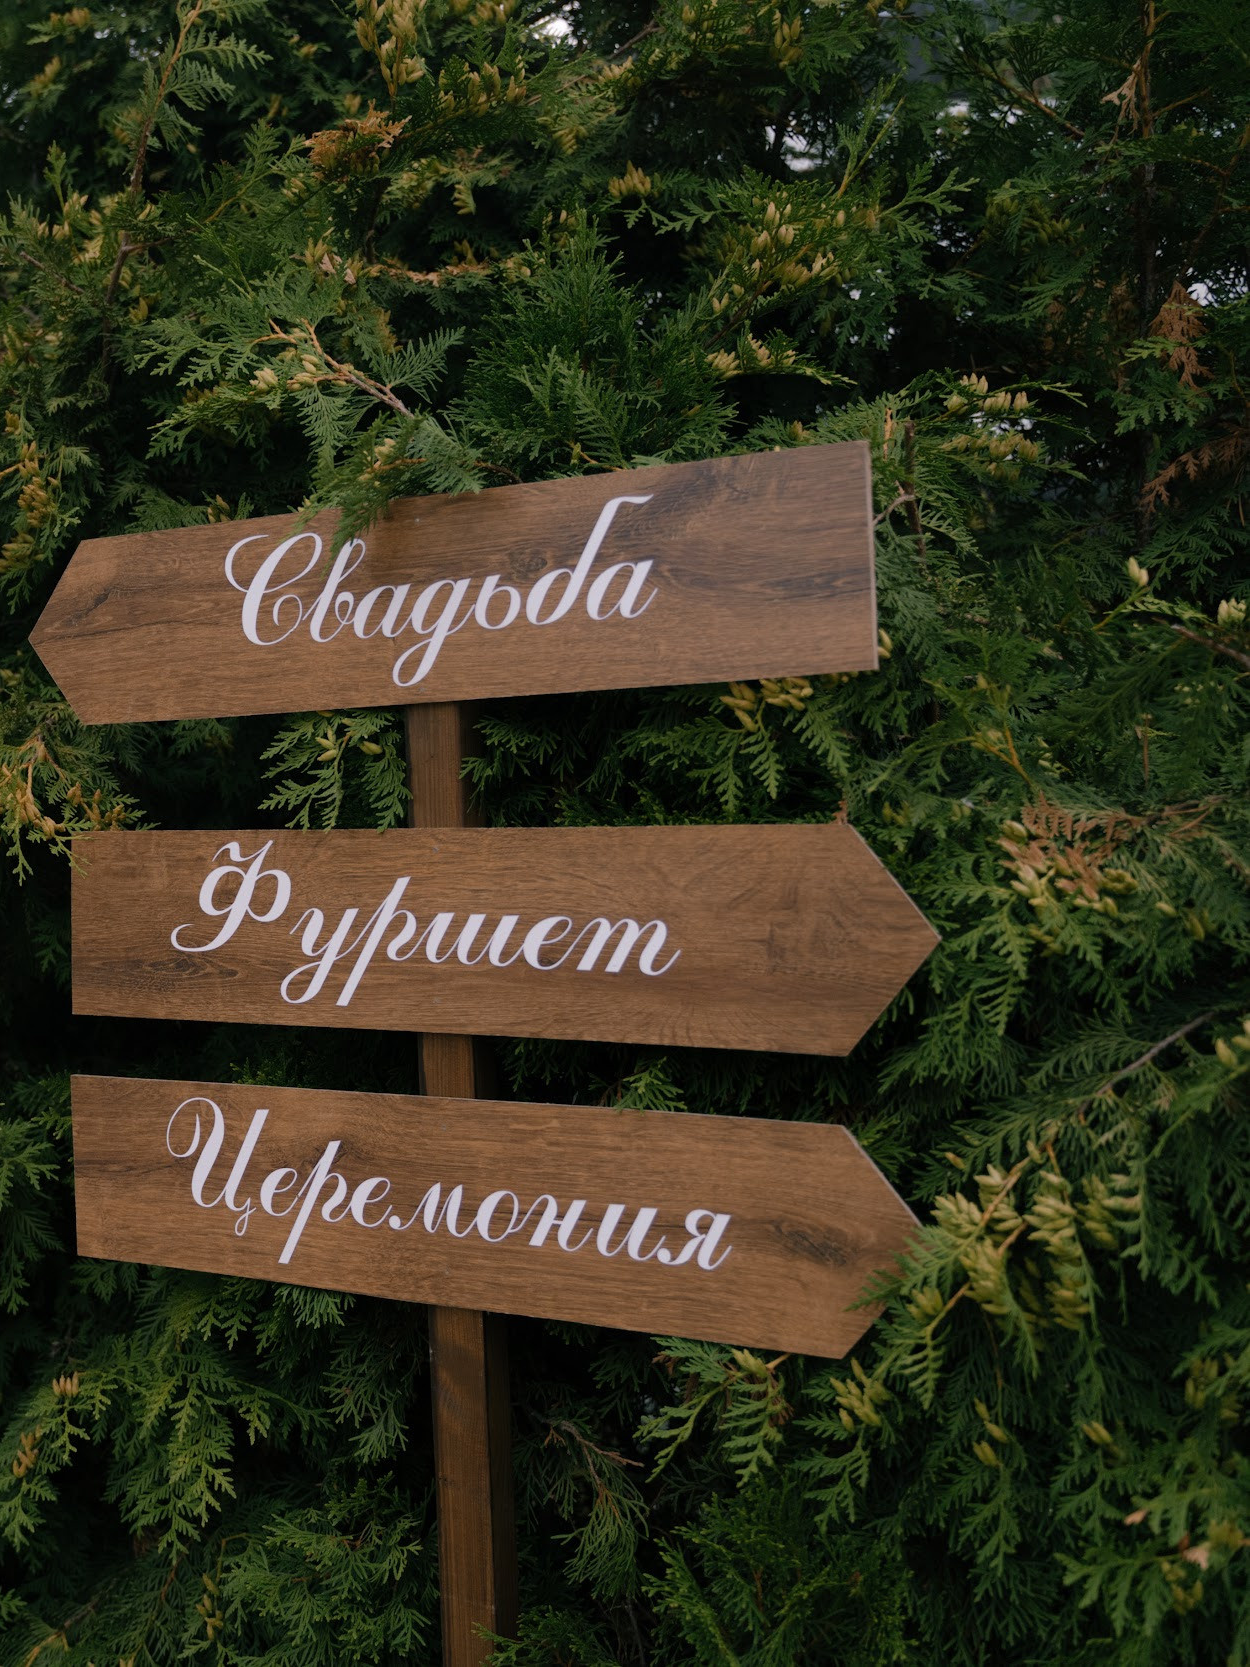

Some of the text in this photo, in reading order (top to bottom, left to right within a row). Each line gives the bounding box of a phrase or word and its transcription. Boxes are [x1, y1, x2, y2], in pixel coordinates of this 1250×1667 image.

[225, 494, 658, 686] Свадьба
[171, 840, 681, 1006] Фуршет
[167, 1097, 733, 1270] Церемония
